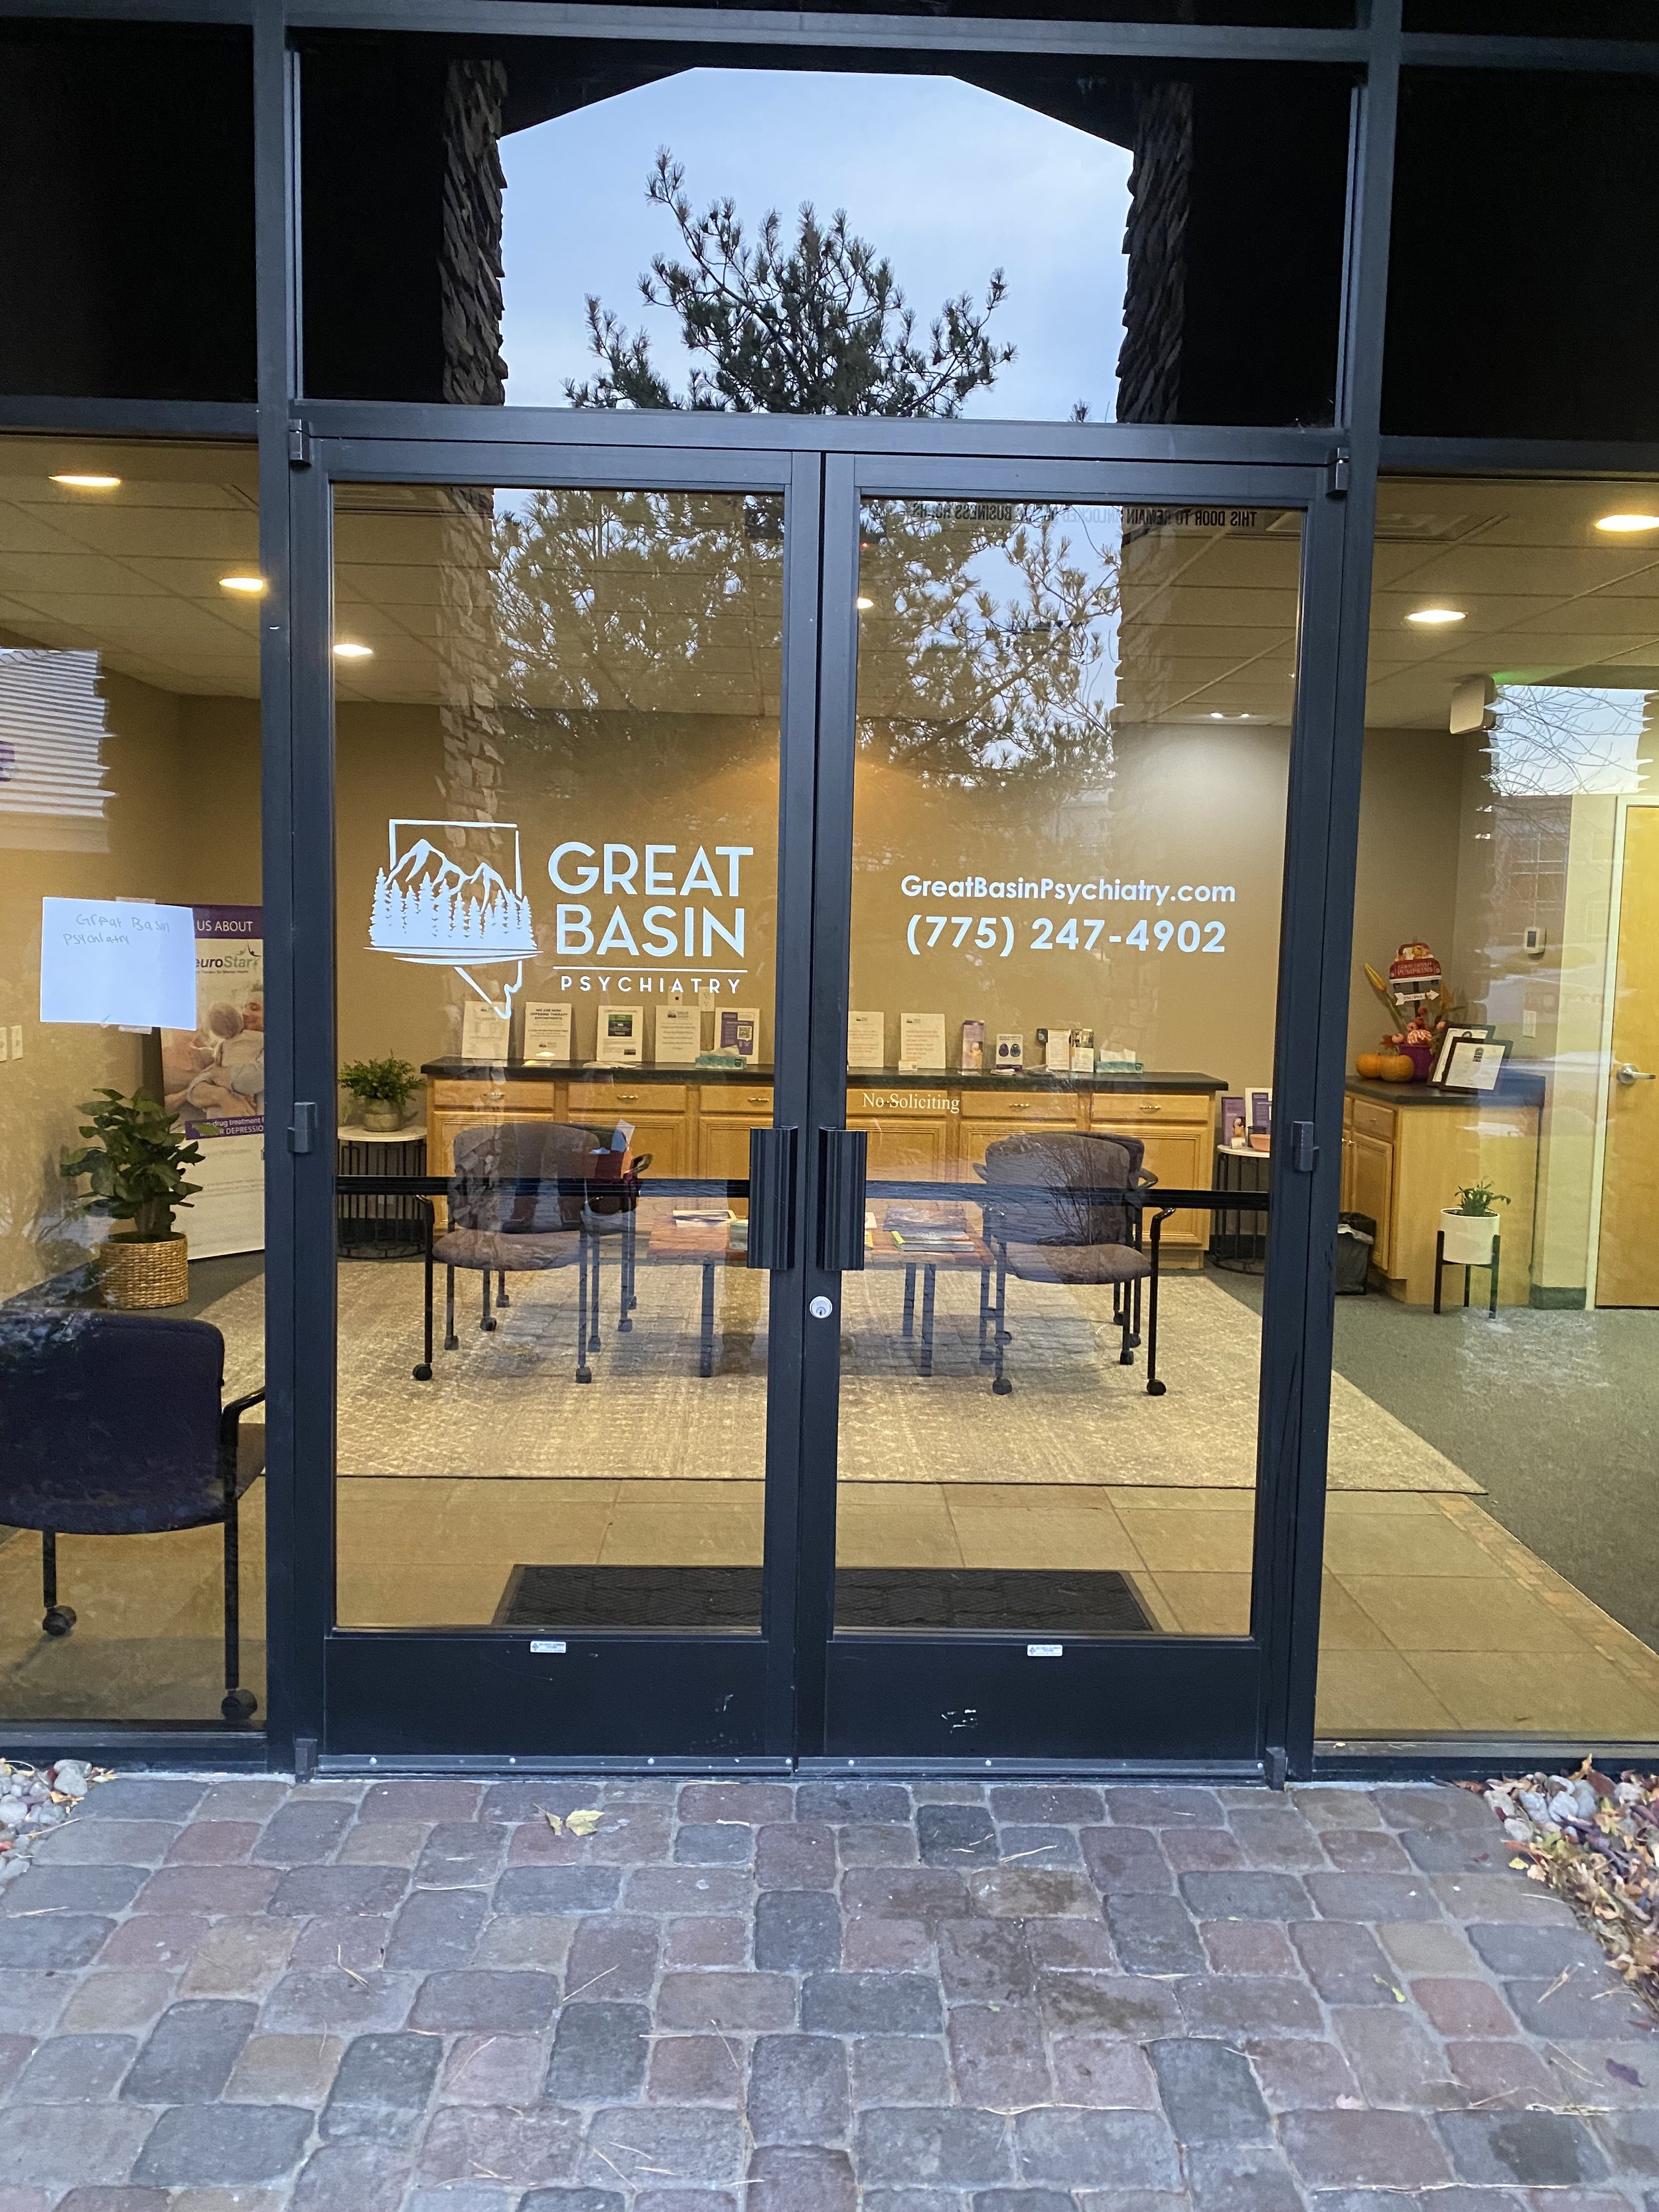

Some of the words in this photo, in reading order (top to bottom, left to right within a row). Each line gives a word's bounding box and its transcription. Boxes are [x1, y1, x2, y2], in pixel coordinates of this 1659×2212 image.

[548, 841, 754, 897] GREAT
[901, 874, 1236, 906] GreatBasinPsychiatry.com
[196, 920, 212, 931] US
[214, 921, 253, 932] ABOUT
[556, 903, 745, 958] BASIN
[906, 914, 1015, 957] (775)
[1030, 917, 1226, 953] 247-4902
[196, 956, 253, 968] euroStar
[1398, 967, 1433, 976] PUMPKINS
[561, 975, 740, 994] PSYCHIATRY
[863, 1092, 885, 1108] No
[889, 1093, 960, 1114] Soliciting
[226, 1125, 264, 1135] DEPRESSIO
[229, 1117, 260, 1126] treatment
